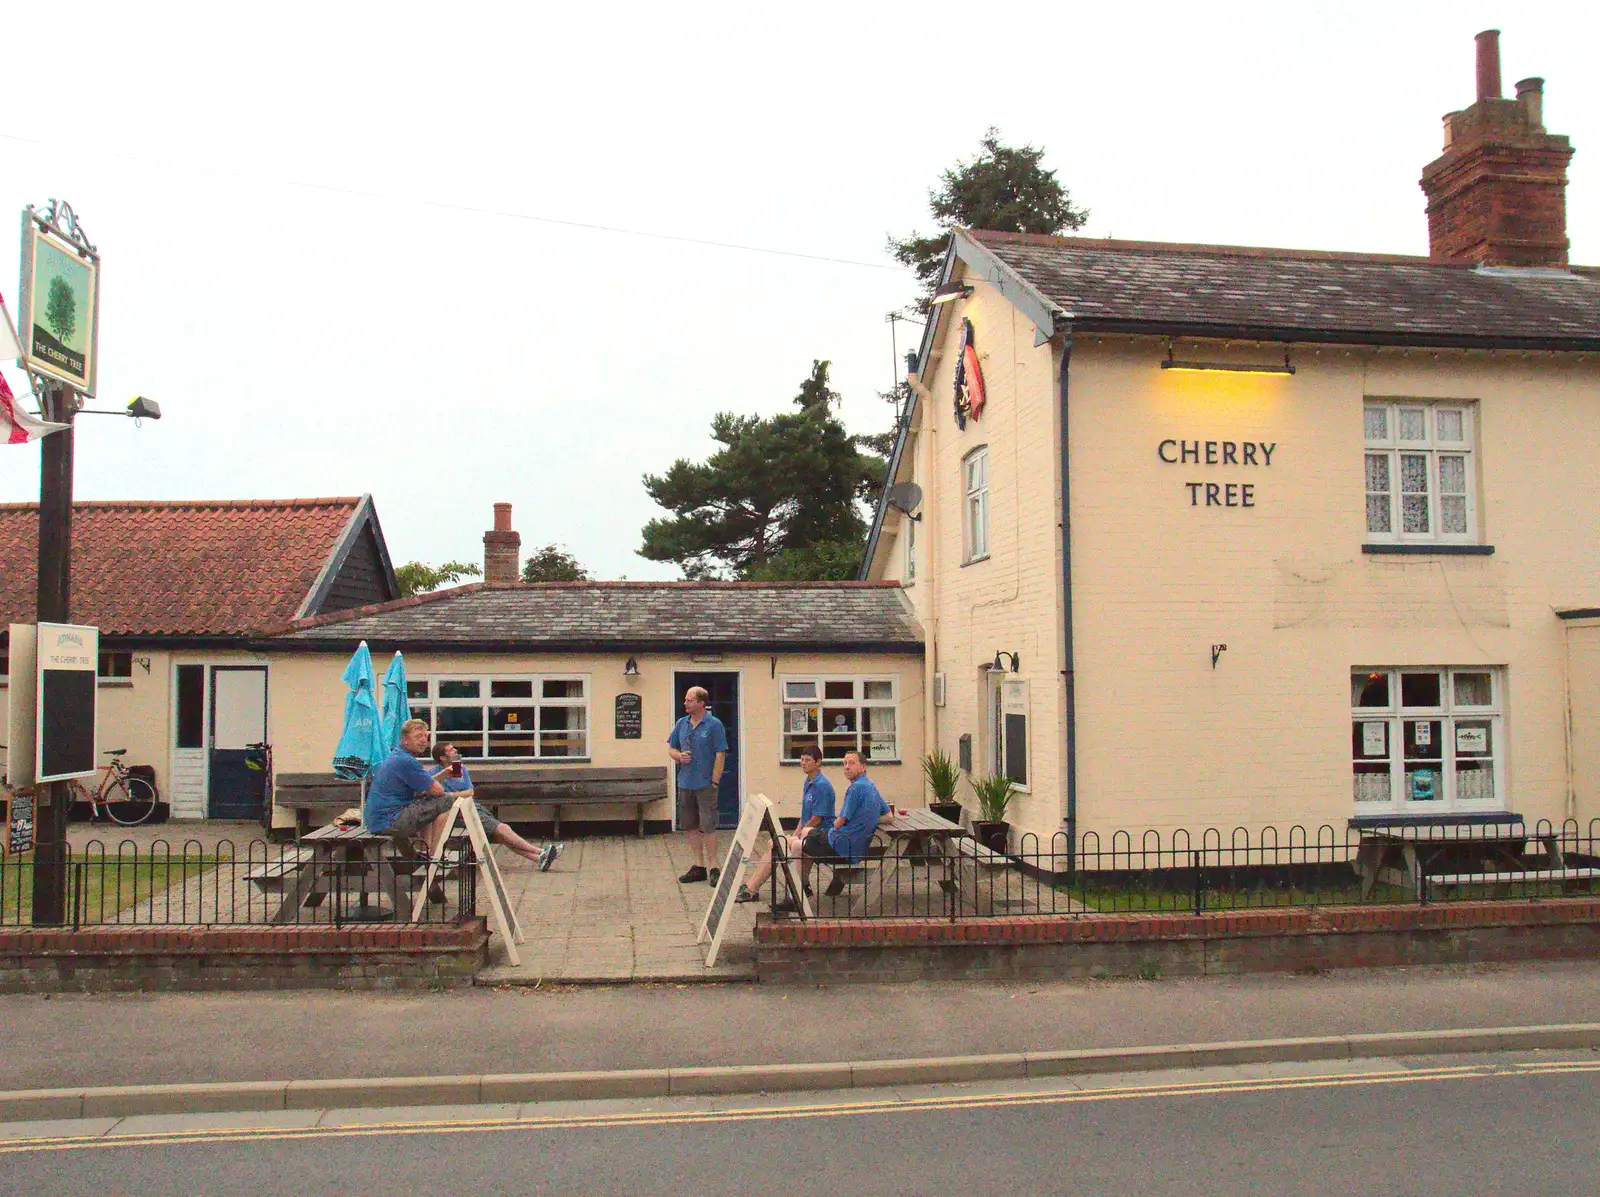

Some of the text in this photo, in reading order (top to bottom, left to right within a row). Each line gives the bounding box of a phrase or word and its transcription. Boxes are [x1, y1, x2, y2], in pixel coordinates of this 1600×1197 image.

[35, 341, 83, 371] THE CHERRY TREE
[1157, 438, 1277, 466] CHERRY
[1185, 482, 1256, 507] TREE
